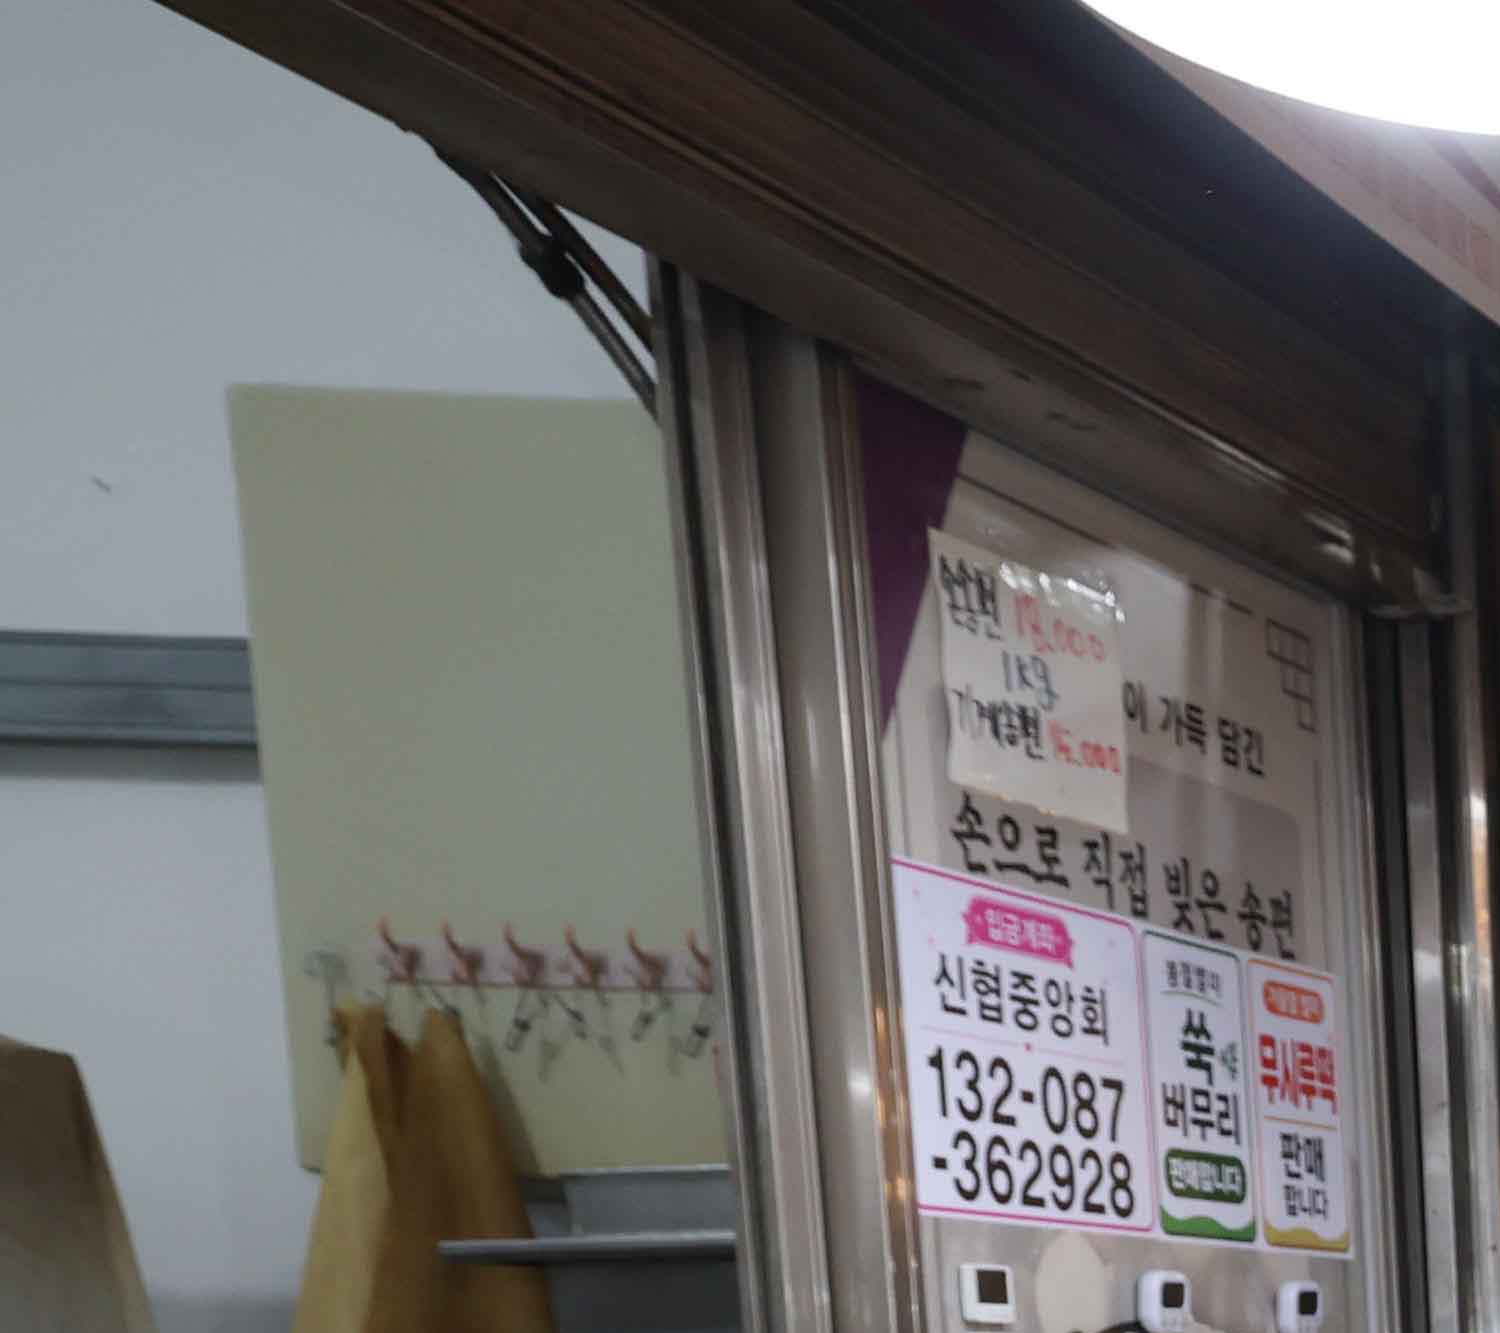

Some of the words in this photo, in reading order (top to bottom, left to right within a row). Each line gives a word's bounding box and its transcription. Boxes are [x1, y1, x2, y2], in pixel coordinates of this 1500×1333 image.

[1158, 695, 1208, 756] 가득
[1217, 713, 1266, 781] 담긴
[950, 789, 1071, 889] 손으로
[1081, 829, 1150, 921] 직접
[1162, 855, 1226, 942] 빚은
[1236, 880, 1297, 962] 송편
[933, 950, 1110, 1047] 신협중앙회
[1180, 1007, 1217, 1088] 쑥
[926, 1044, 1127, 1143] 132-087
[1161, 1080, 1242, 1147] 버무리
[1279, 1131, 1326, 1183] 판매
